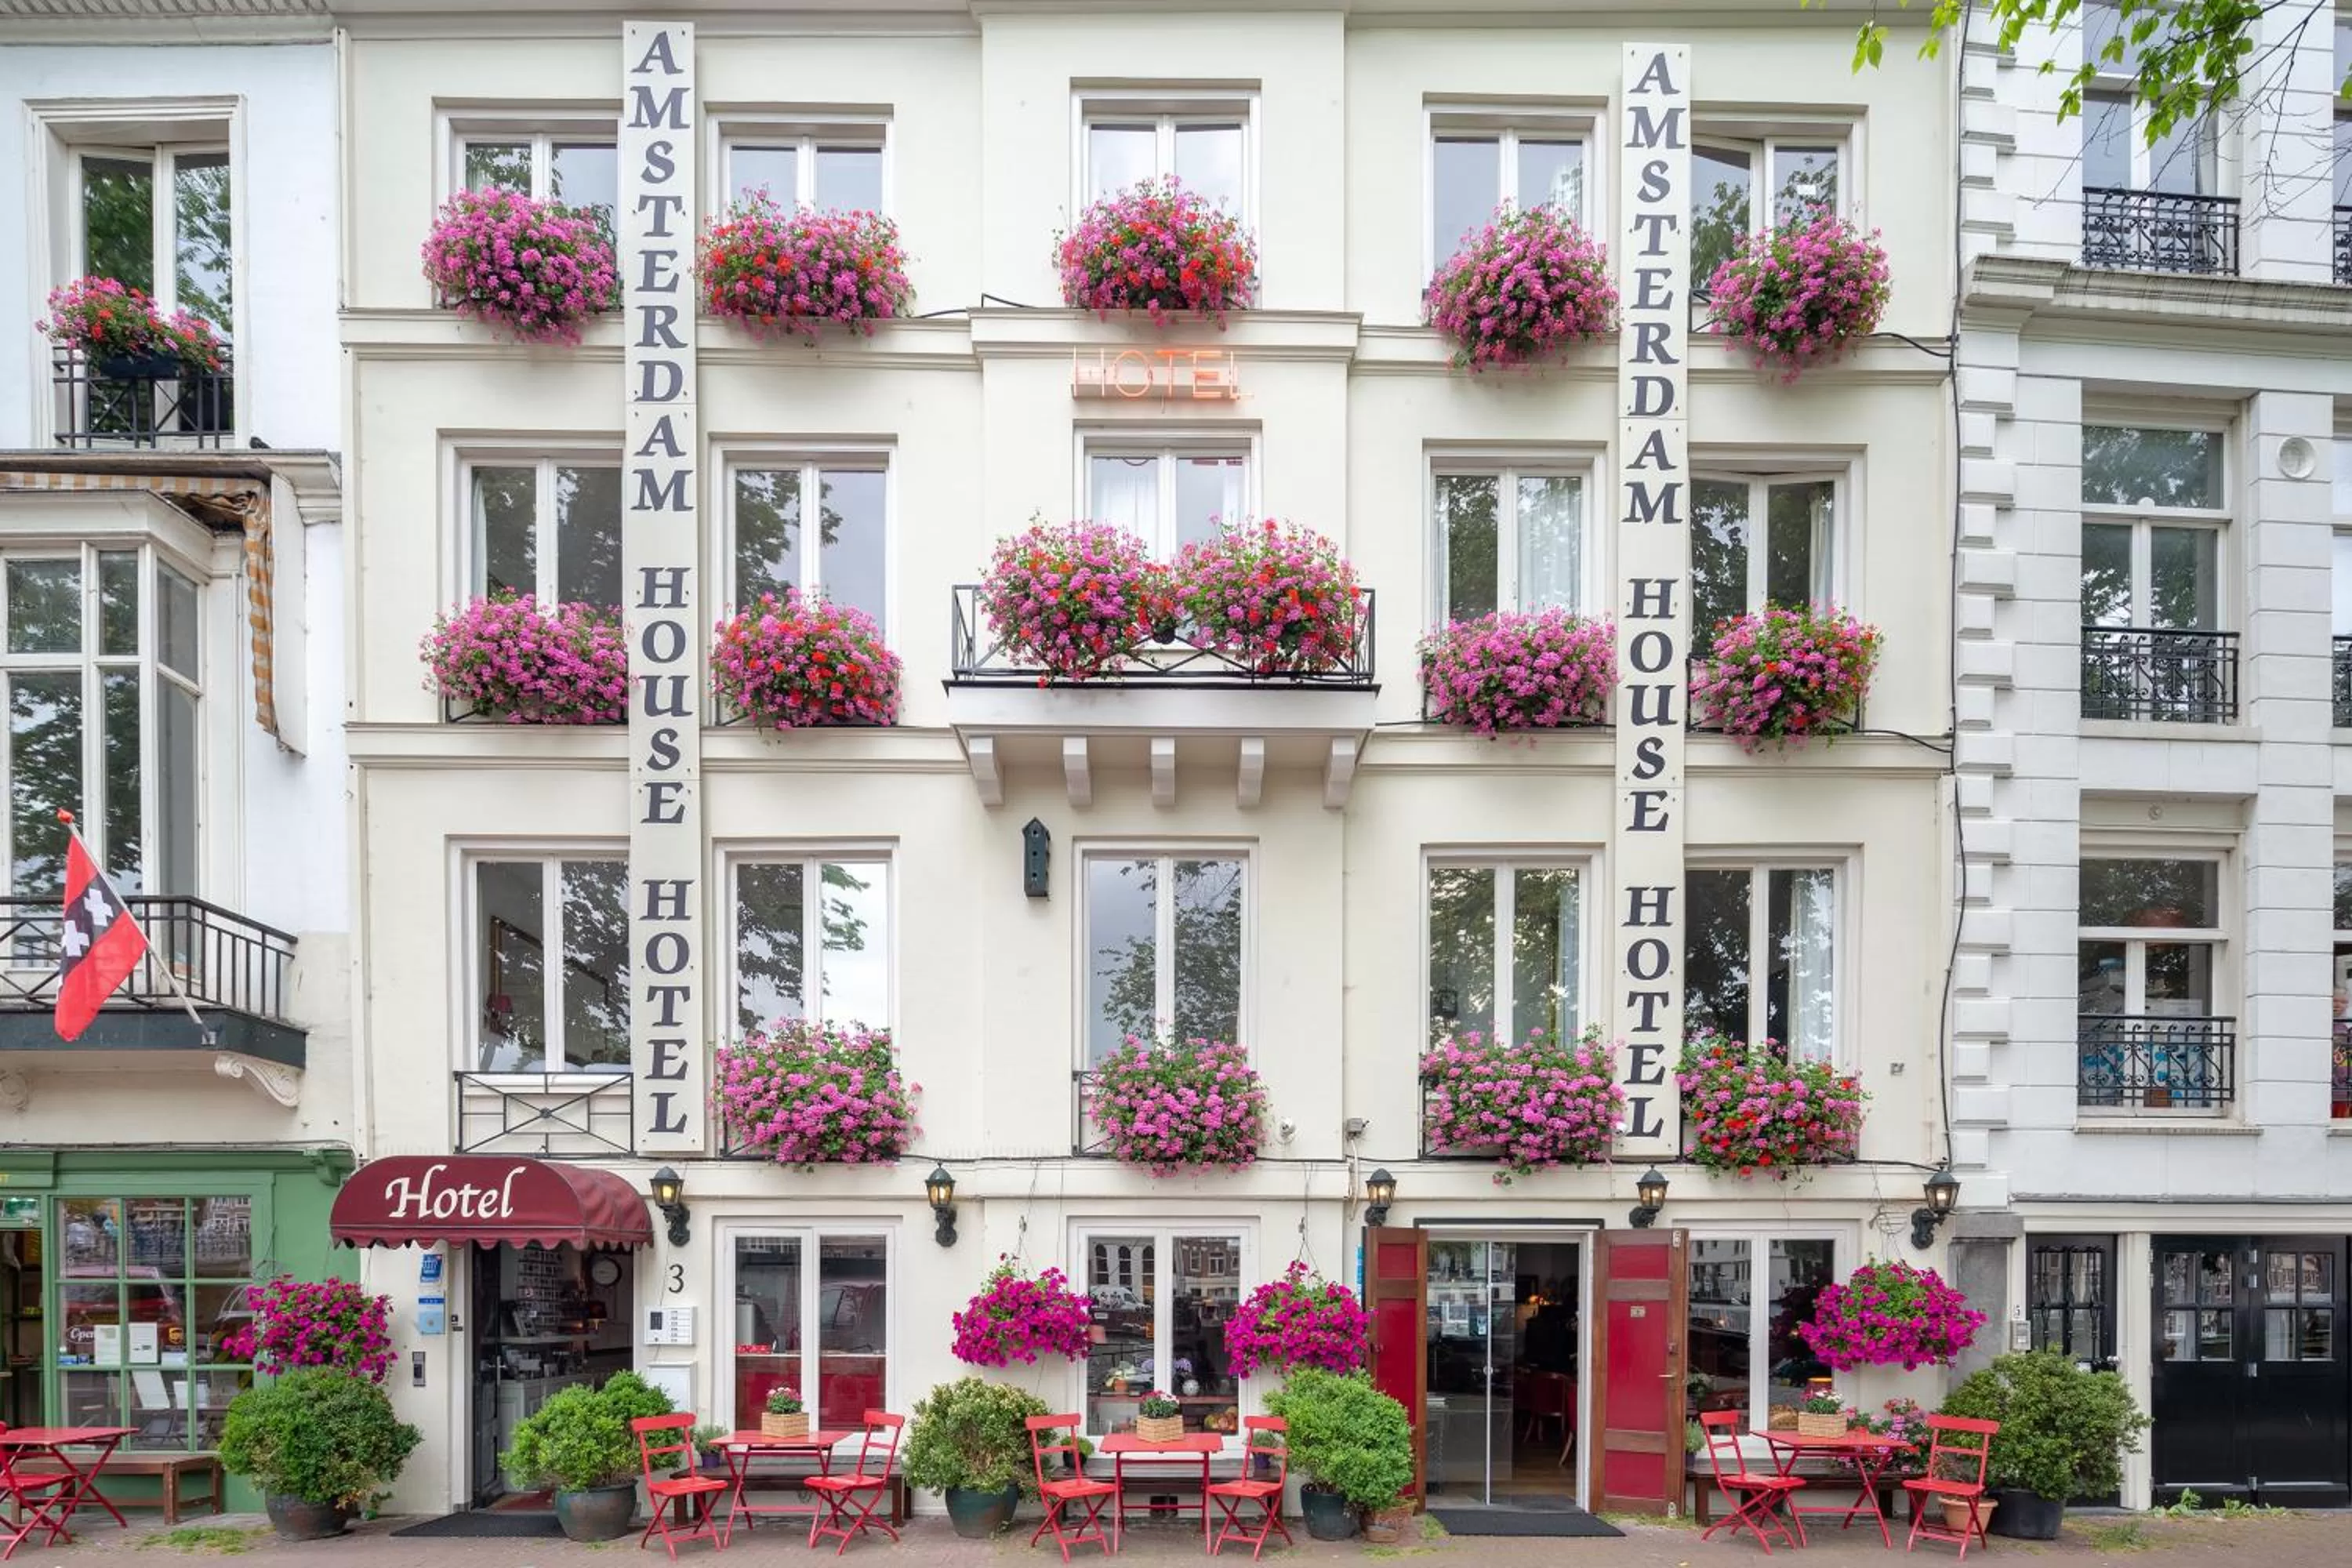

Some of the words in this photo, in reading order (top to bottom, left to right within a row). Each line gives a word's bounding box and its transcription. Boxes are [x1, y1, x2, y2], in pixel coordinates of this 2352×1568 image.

[626, 30, 694, 513] AMSTERDAM
[1073, 345, 1253, 398] HOTEL
[1622, 52, 1686, 525] AMSTERDAM
[636, 567, 694, 825] HOUSE
[1625, 578, 1679, 832] HOUSE
[638, 879, 694, 1134] HOTEL
[1622, 886, 1676, 1139] HOTEL
[385, 1164, 526, 1219] Hotel
[669, 1263, 684, 1294] 3
